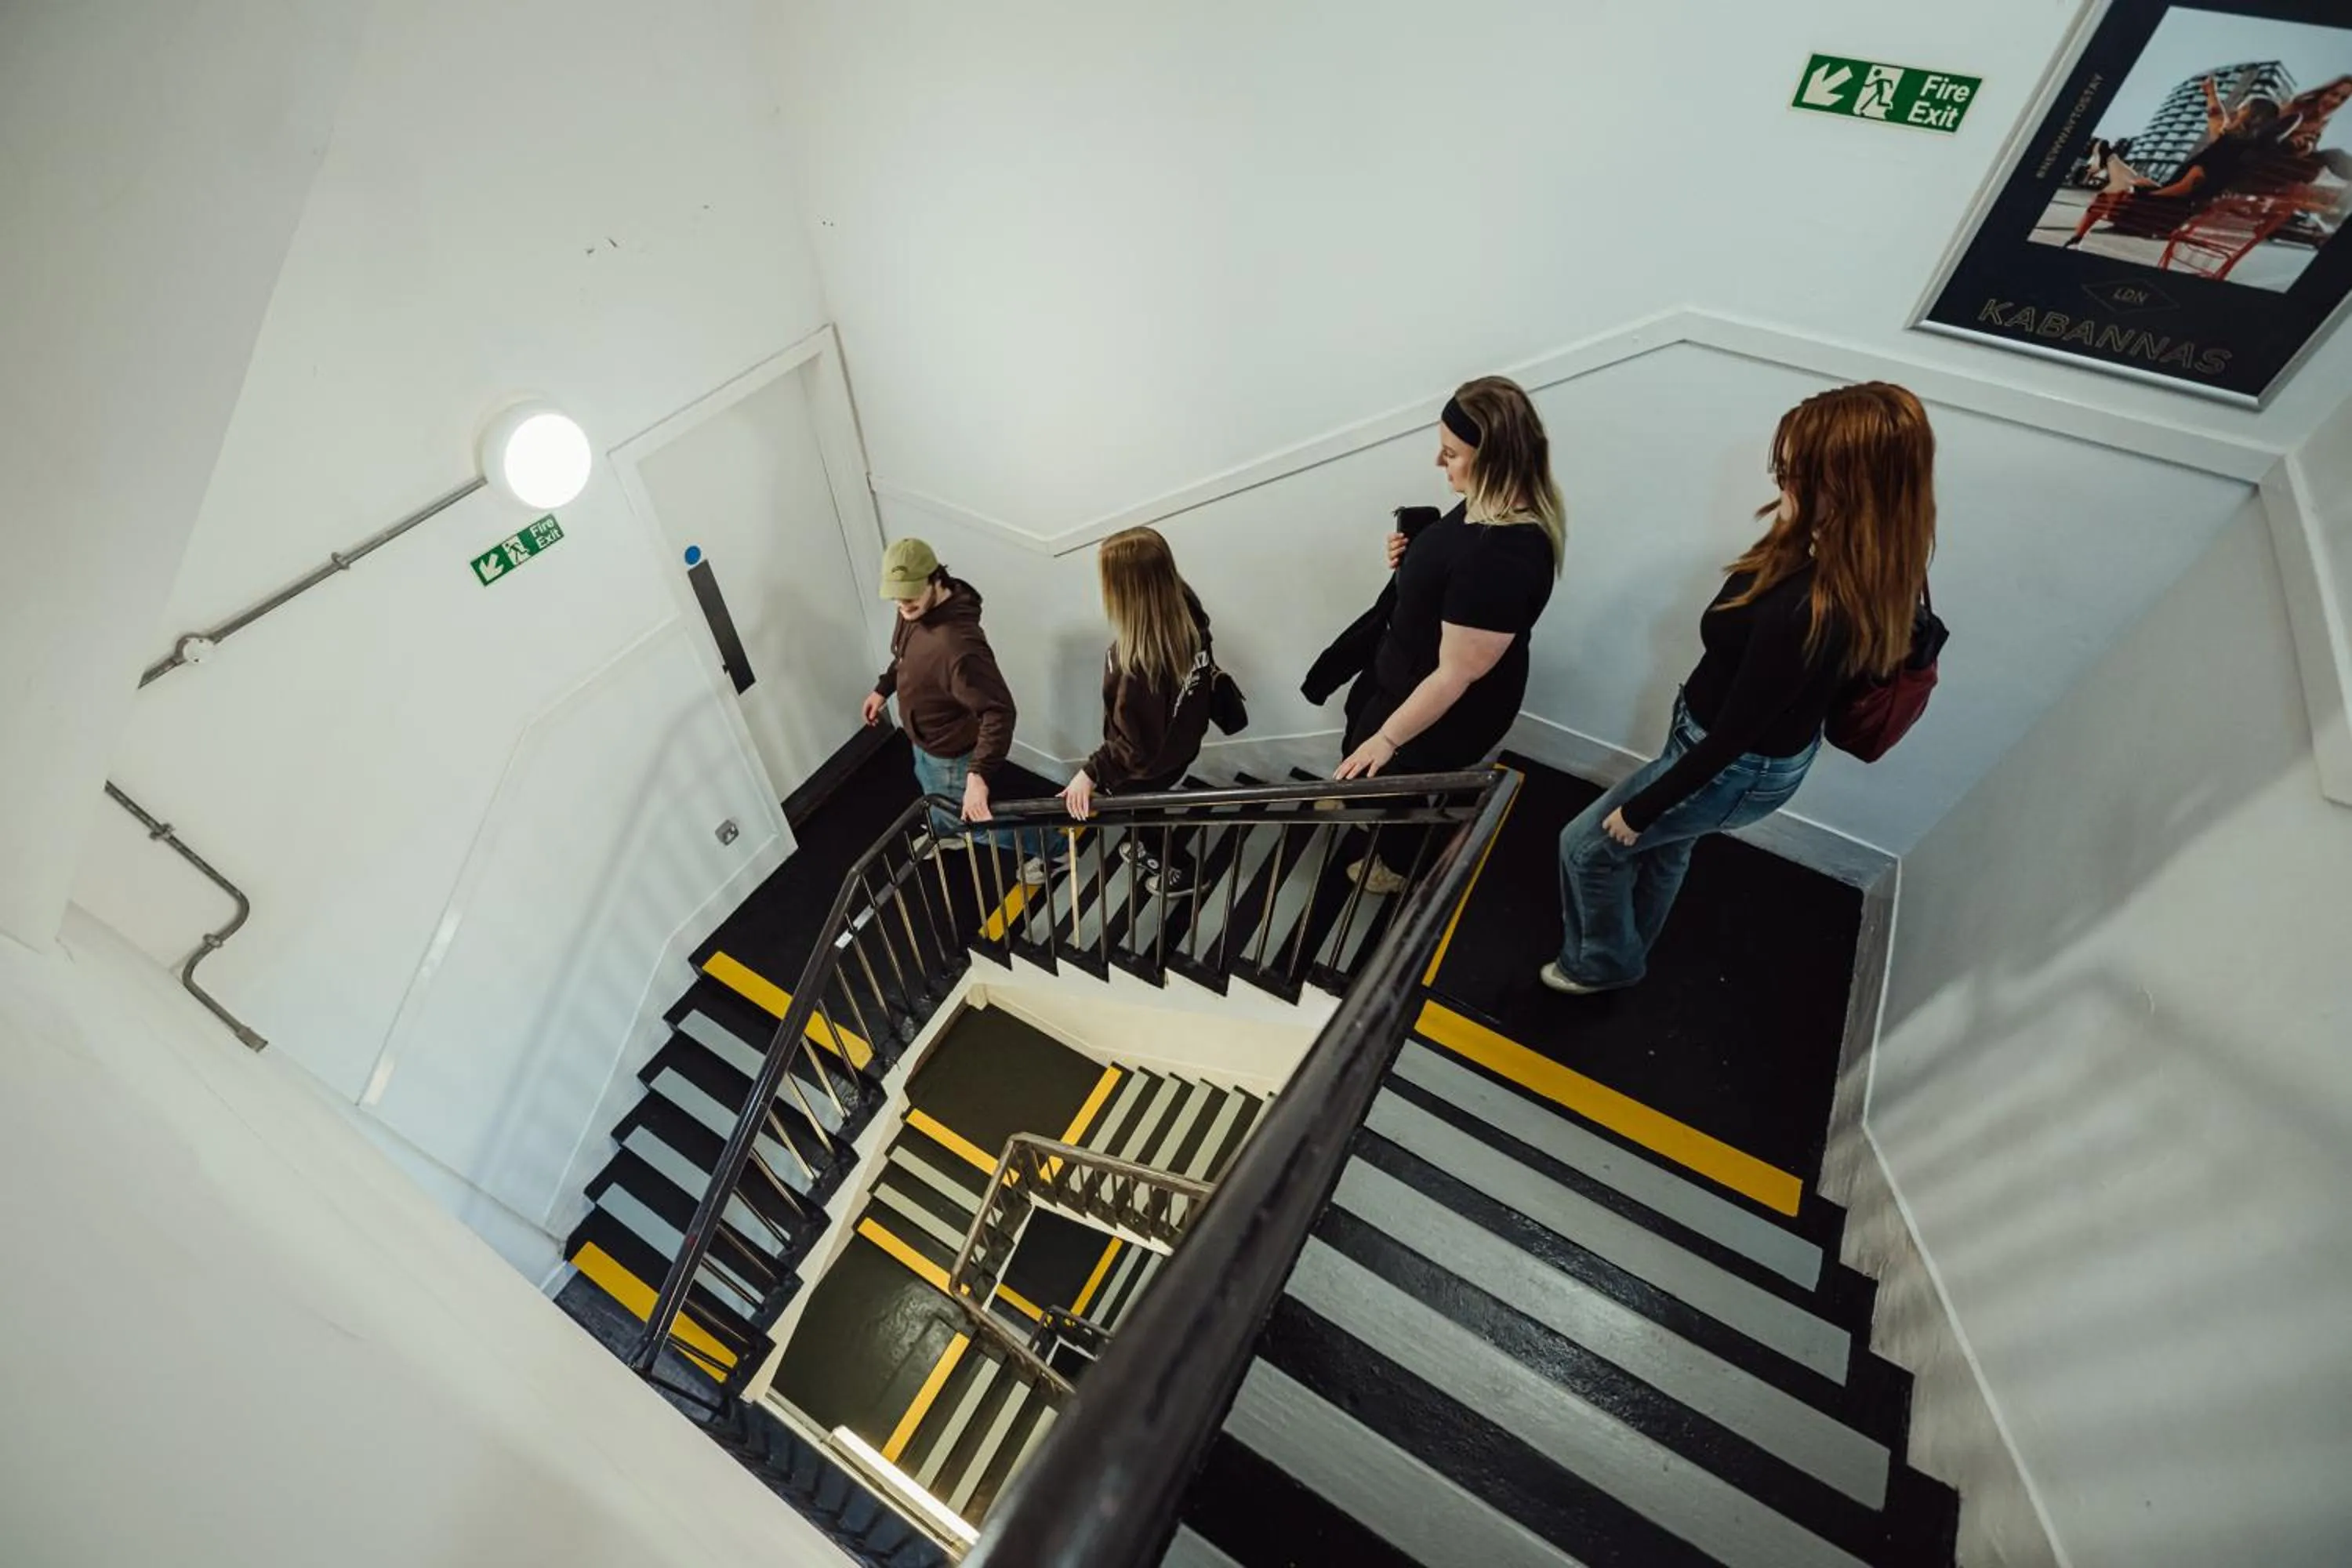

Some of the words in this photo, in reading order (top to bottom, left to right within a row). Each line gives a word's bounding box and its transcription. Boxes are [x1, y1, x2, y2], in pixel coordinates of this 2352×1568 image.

[1920, 74, 1970, 103] Fire
[1907, 100, 1959, 129] Exit
[2114, 288, 2148, 305] LDN
[1978, 299, 2232, 374] KABANNAS
[529, 518, 554, 537] Fire
[535, 529, 561, 549] Exit
